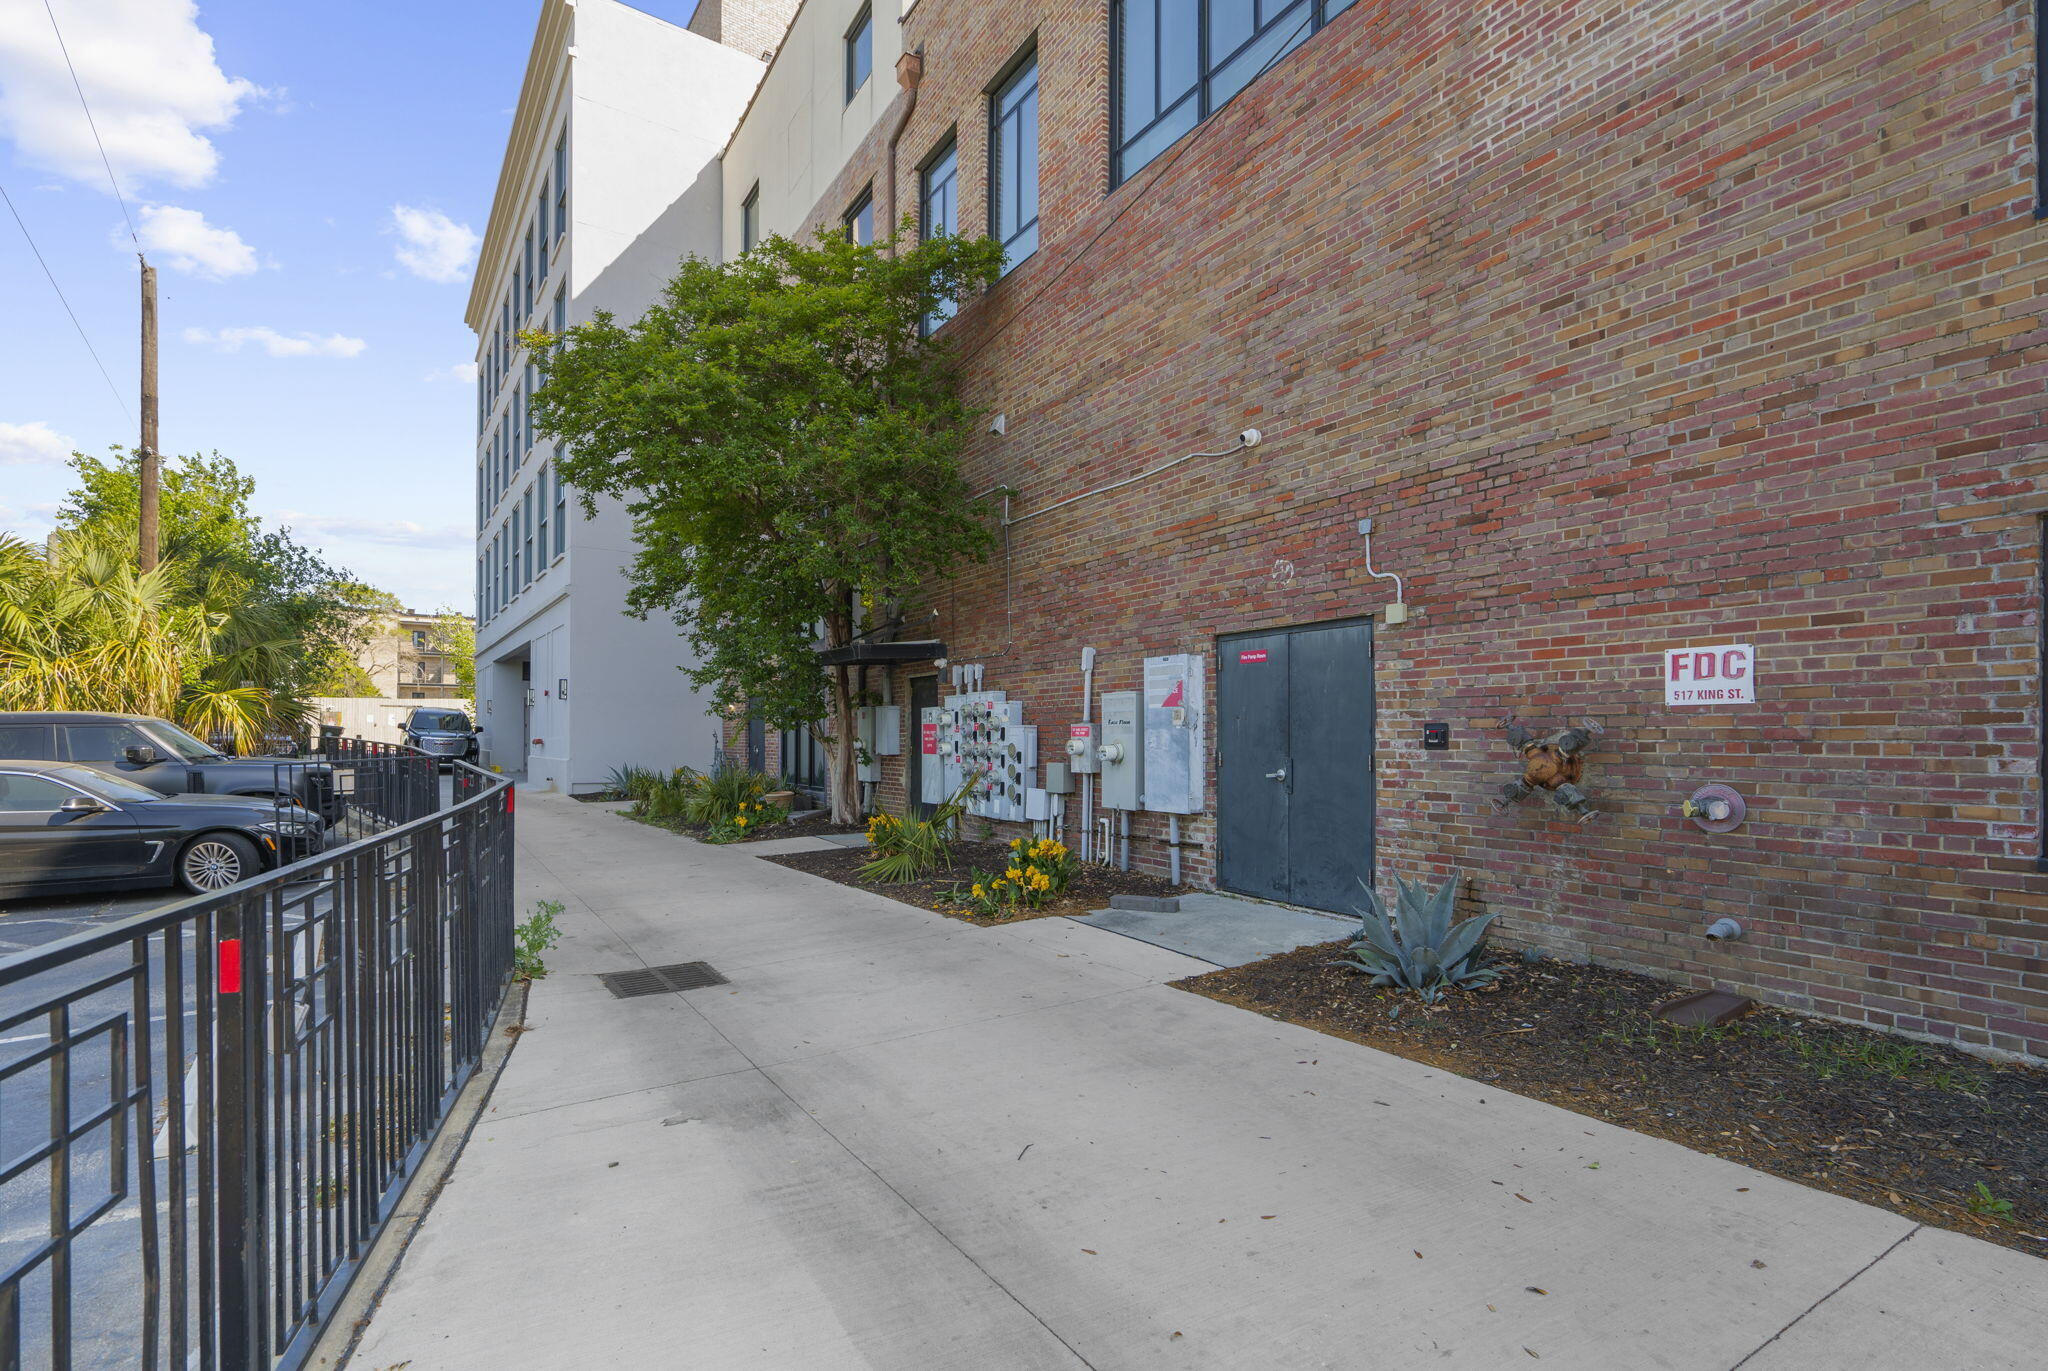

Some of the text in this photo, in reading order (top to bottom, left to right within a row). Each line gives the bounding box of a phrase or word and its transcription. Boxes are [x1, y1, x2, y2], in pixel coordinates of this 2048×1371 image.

[1671, 650, 1746, 681] FDC
[1674, 688, 1744, 701] 517 KING ST.
